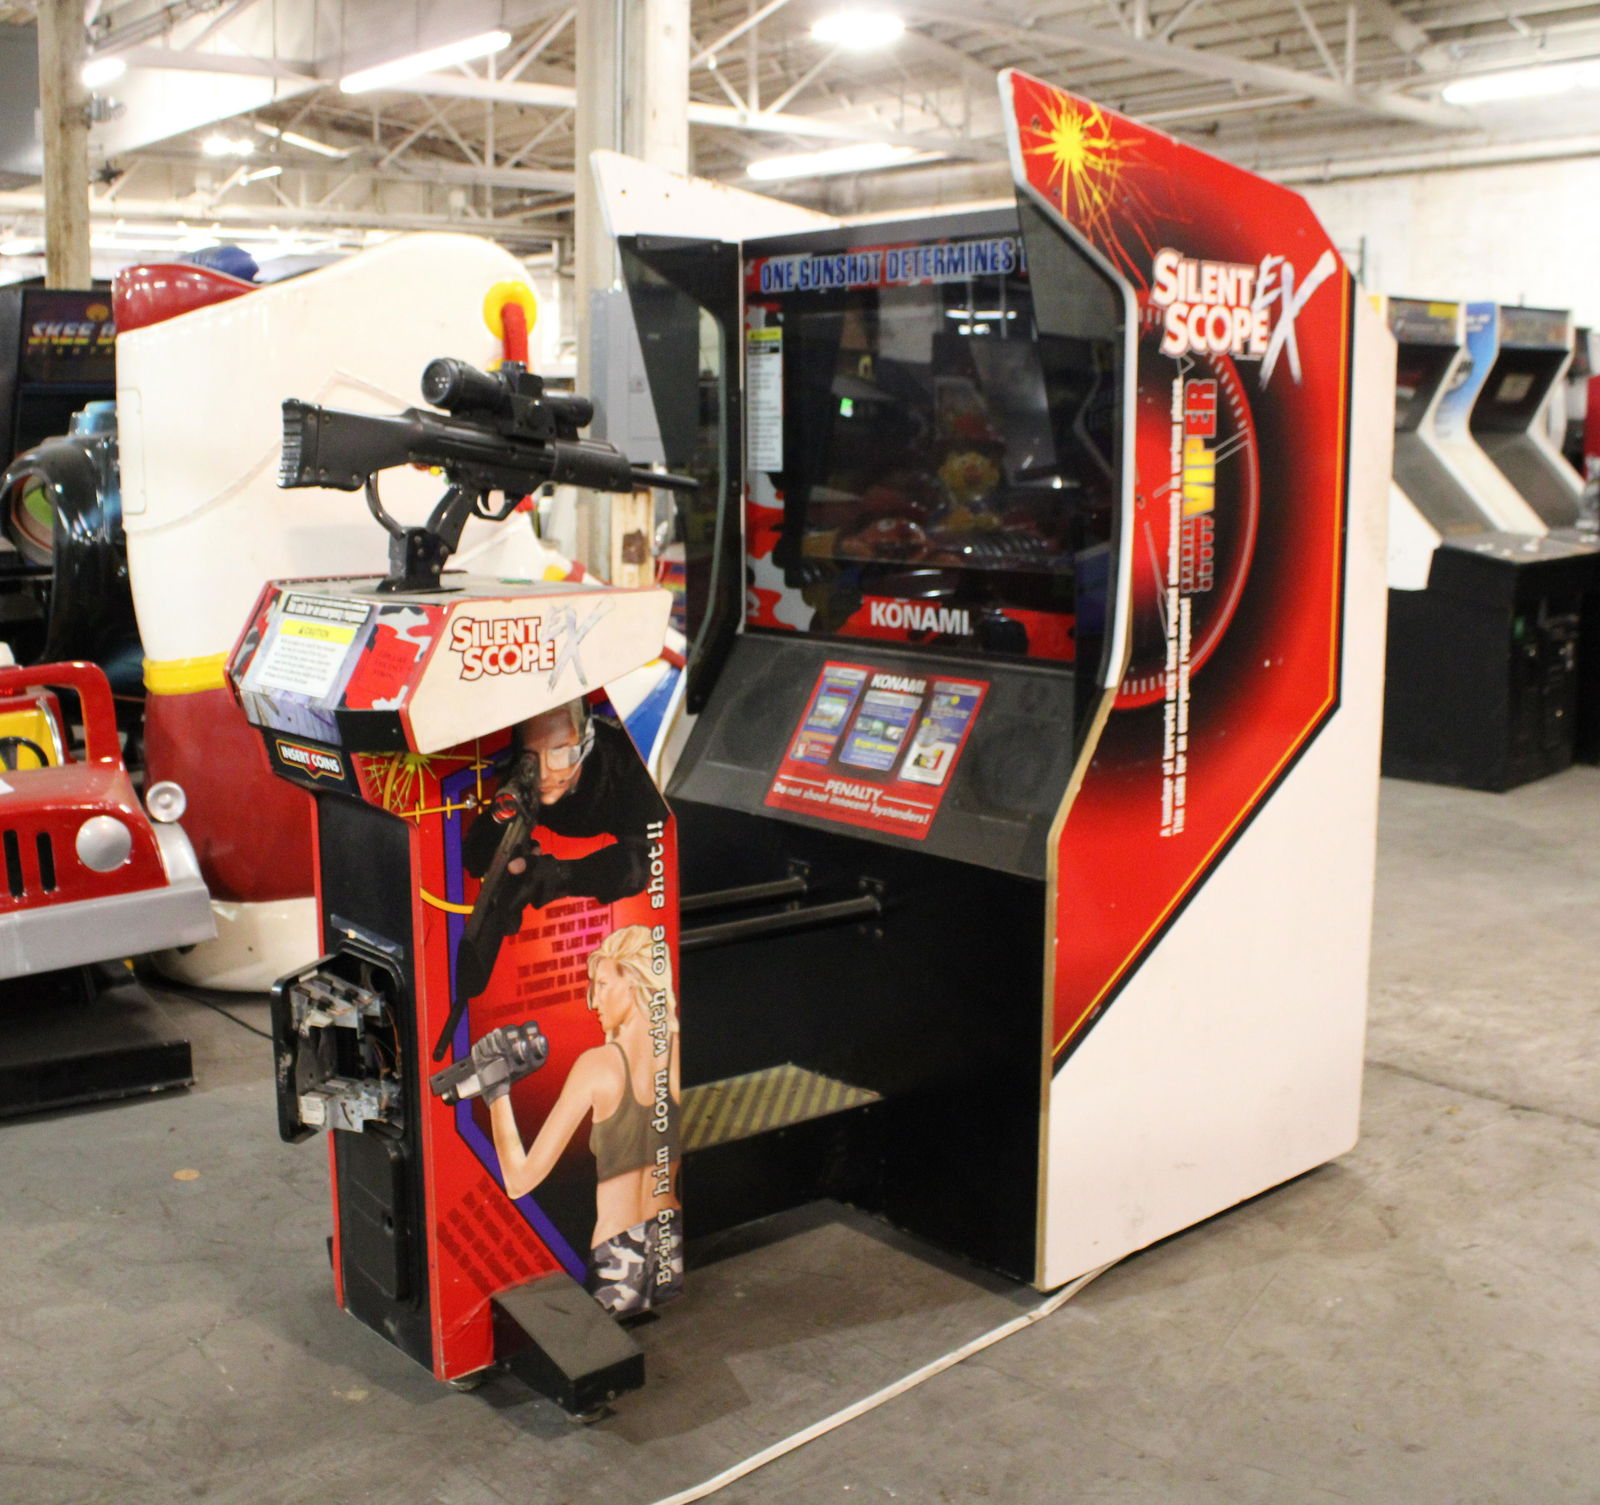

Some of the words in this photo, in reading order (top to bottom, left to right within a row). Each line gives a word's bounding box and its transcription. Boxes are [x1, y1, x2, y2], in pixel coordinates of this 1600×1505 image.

[759, 262, 793, 294] ONE
[799, 252, 882, 291] GUNSHOT
[885, 237, 1016, 283] DETERMINES
[1153, 247, 1257, 309] SILENT
[1159, 300, 1272, 360] SCOPE
[1182, 378, 1217, 519] VIPER
[449, 616, 541, 652] SILENT
[871, 602, 970, 635] KONAMI
[460, 640, 556, 681] SCOPE
[871, 673, 927, 694] KONAMI
[281, 746, 311, 765] INSERT
[312, 753, 340, 772] COINS
[773, 782, 786, 794] Do
[824, 779, 883, 801] PENALTY
[647, 820, 664, 909] shot!!
[652, 924, 666, 975] one
[649, 989, 667, 1057] with
[652, 1069, 668, 1133] down
[653, 1145, 670, 1198] him
[656, 1208, 674, 1286] Bring
